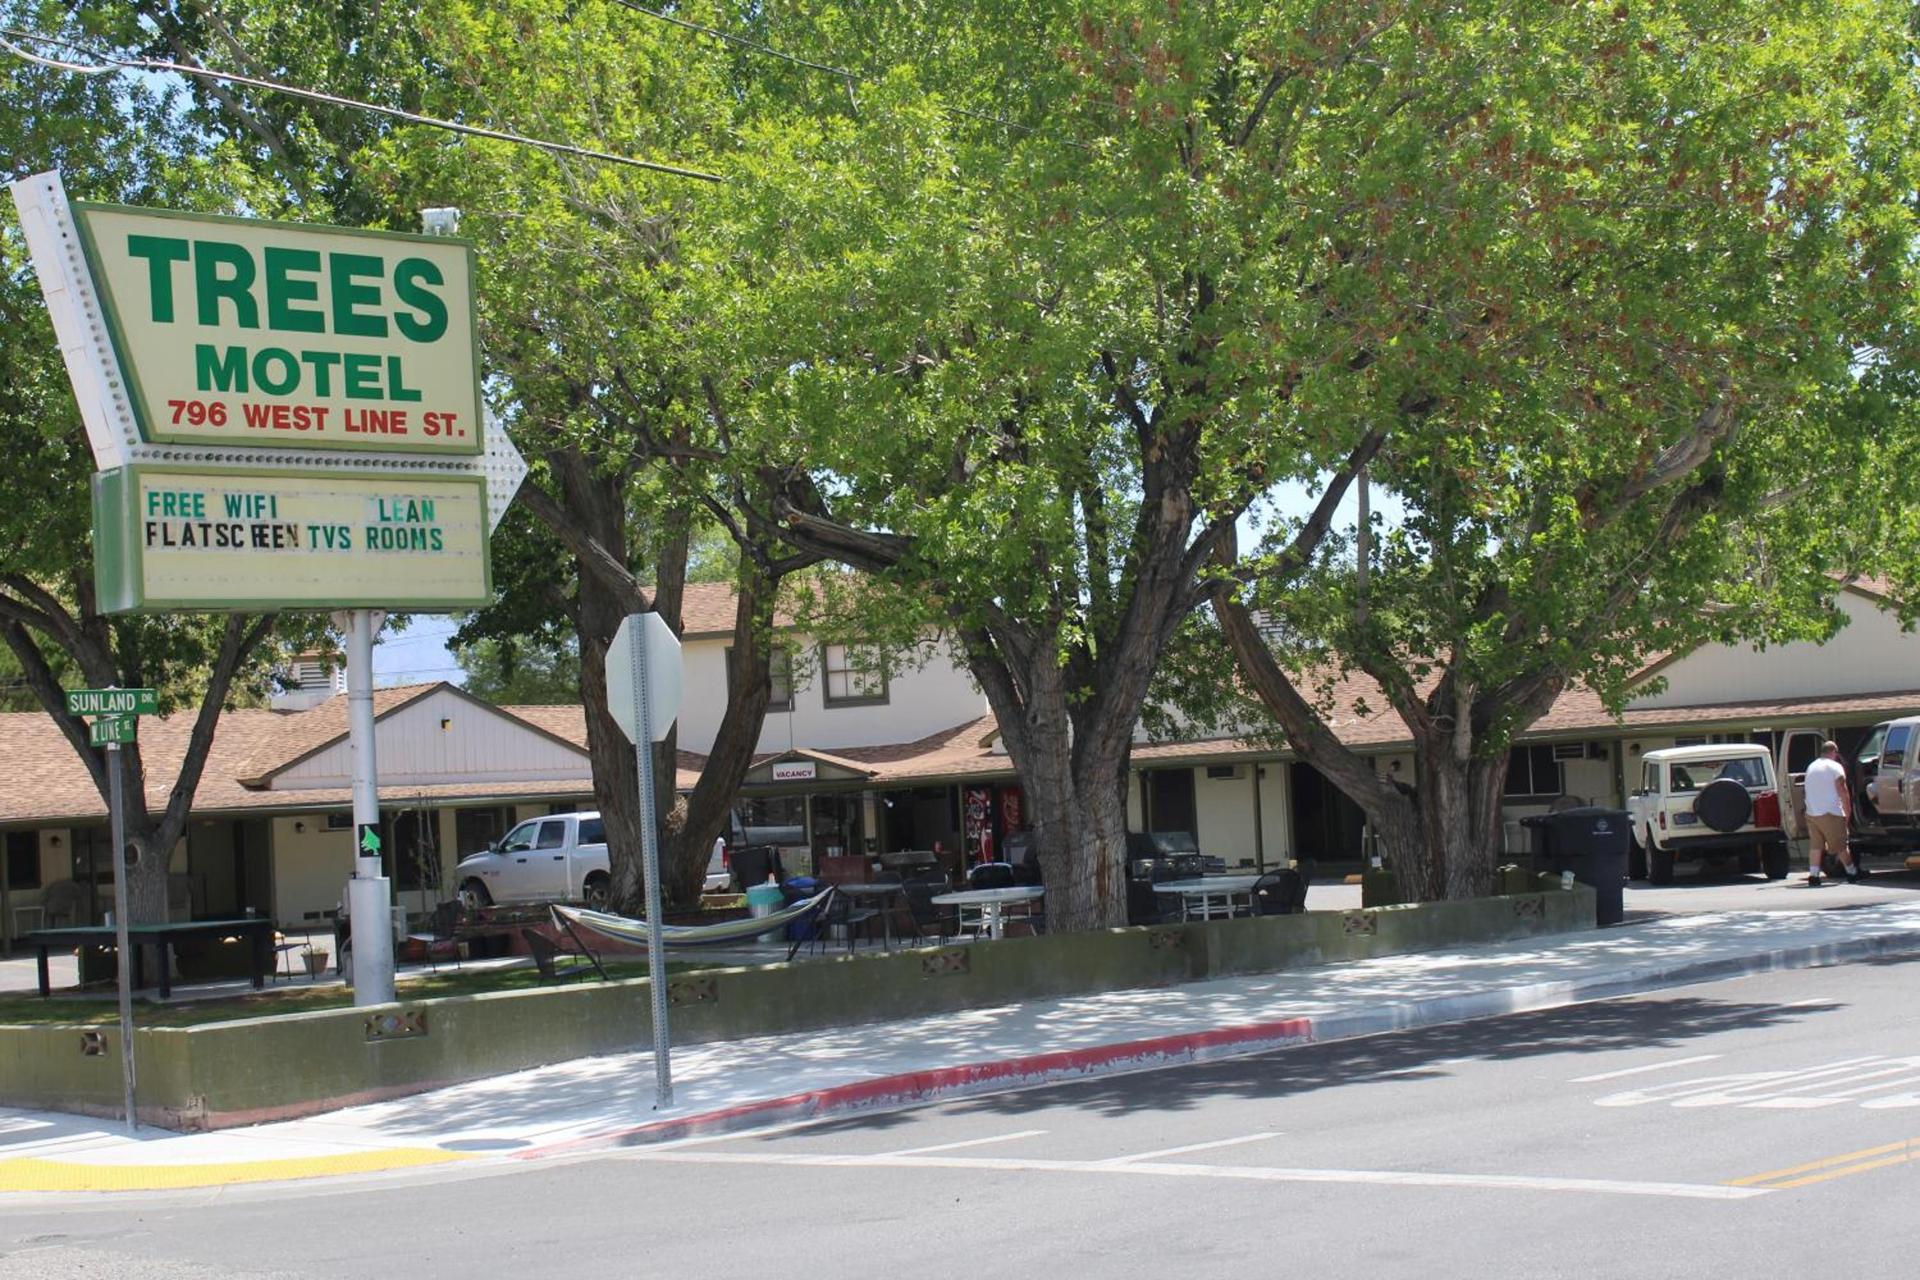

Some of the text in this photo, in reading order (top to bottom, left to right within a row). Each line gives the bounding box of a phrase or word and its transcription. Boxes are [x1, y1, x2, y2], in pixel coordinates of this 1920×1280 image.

[127, 234, 449, 343] TREES
[195, 344, 422, 402] MOTEL
[168, 400, 465, 437] 796 WEST LINE ST.
[147, 491, 435, 523] FREE WIFI LEAN
[307, 526, 351, 550] TVS
[366, 527, 444, 551] ROOMS
[70, 694, 136, 712] SUNLAND
[100, 721, 121, 741] LINE
[776, 770, 812, 778] VACANCY
